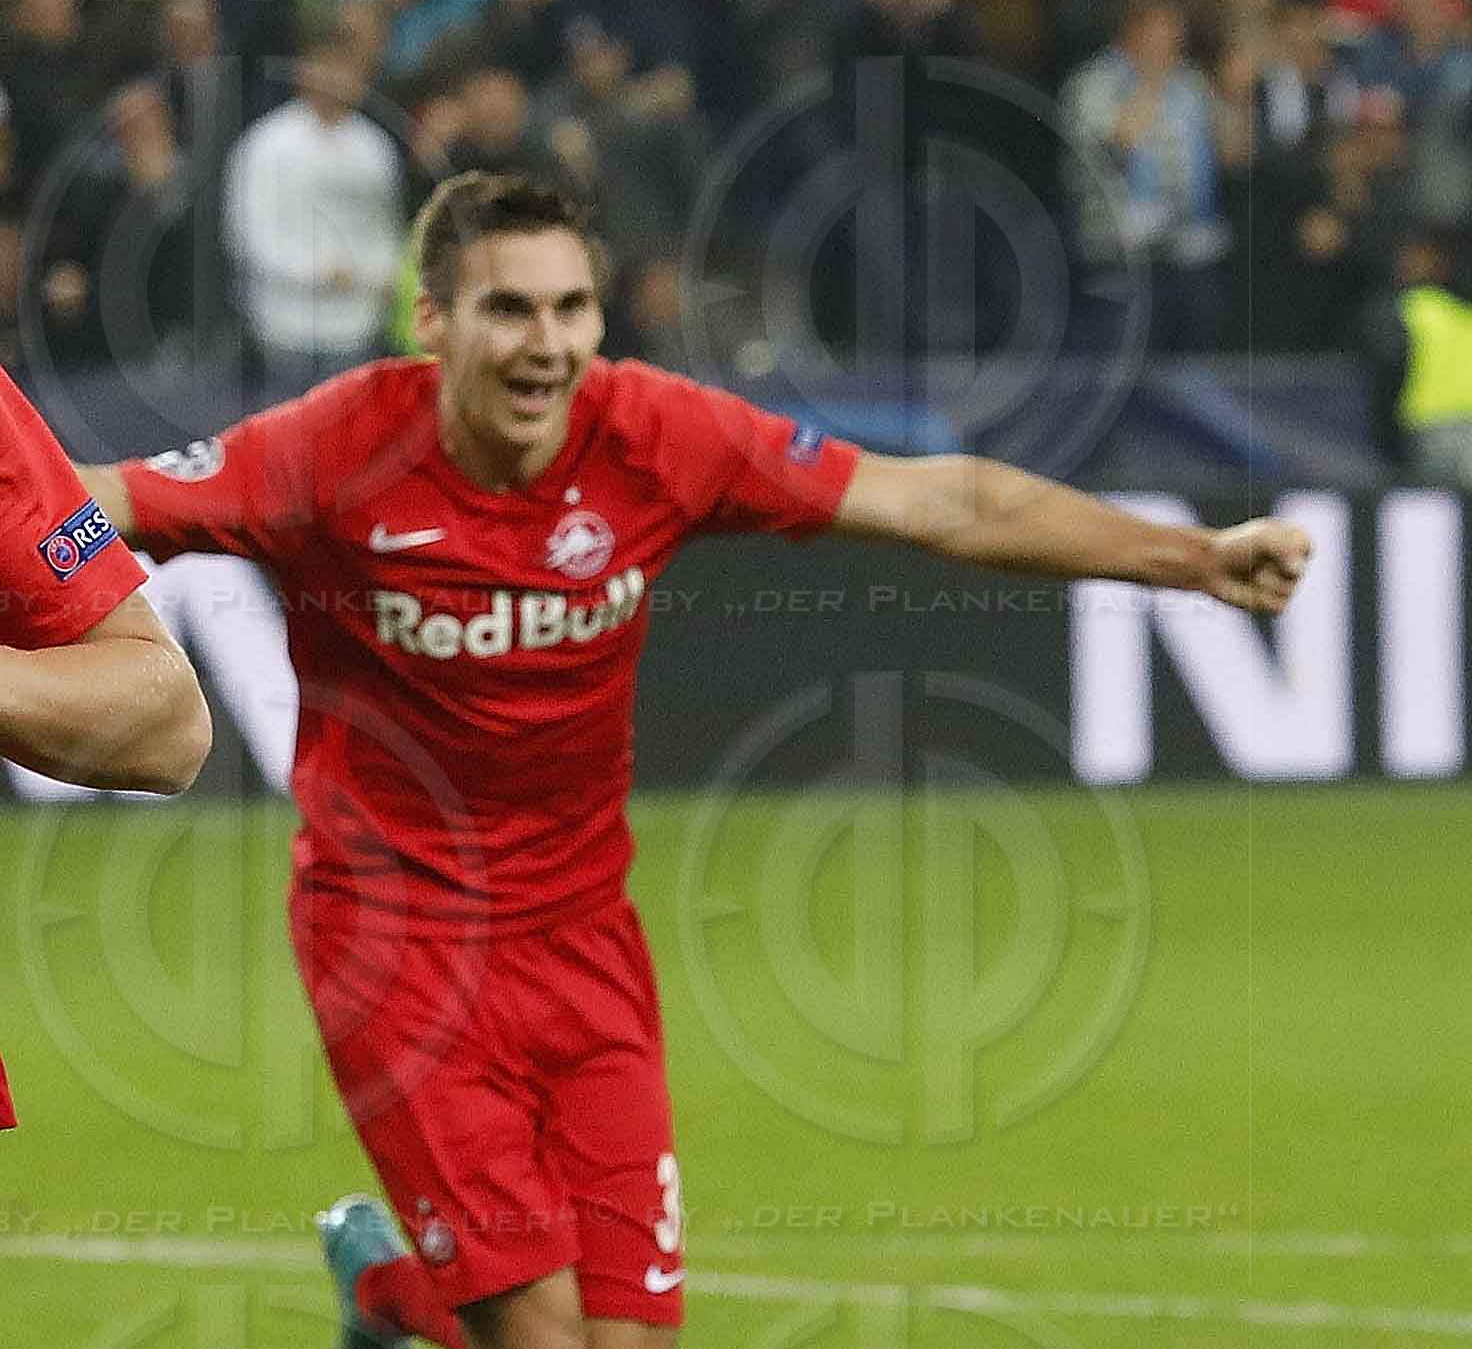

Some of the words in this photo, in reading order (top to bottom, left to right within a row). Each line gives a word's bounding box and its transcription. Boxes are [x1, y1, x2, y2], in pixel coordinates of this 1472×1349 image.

[72, 507, 112, 549] RES
[372, 589, 513, 661] Red
[519, 563, 647, 650] Bull
